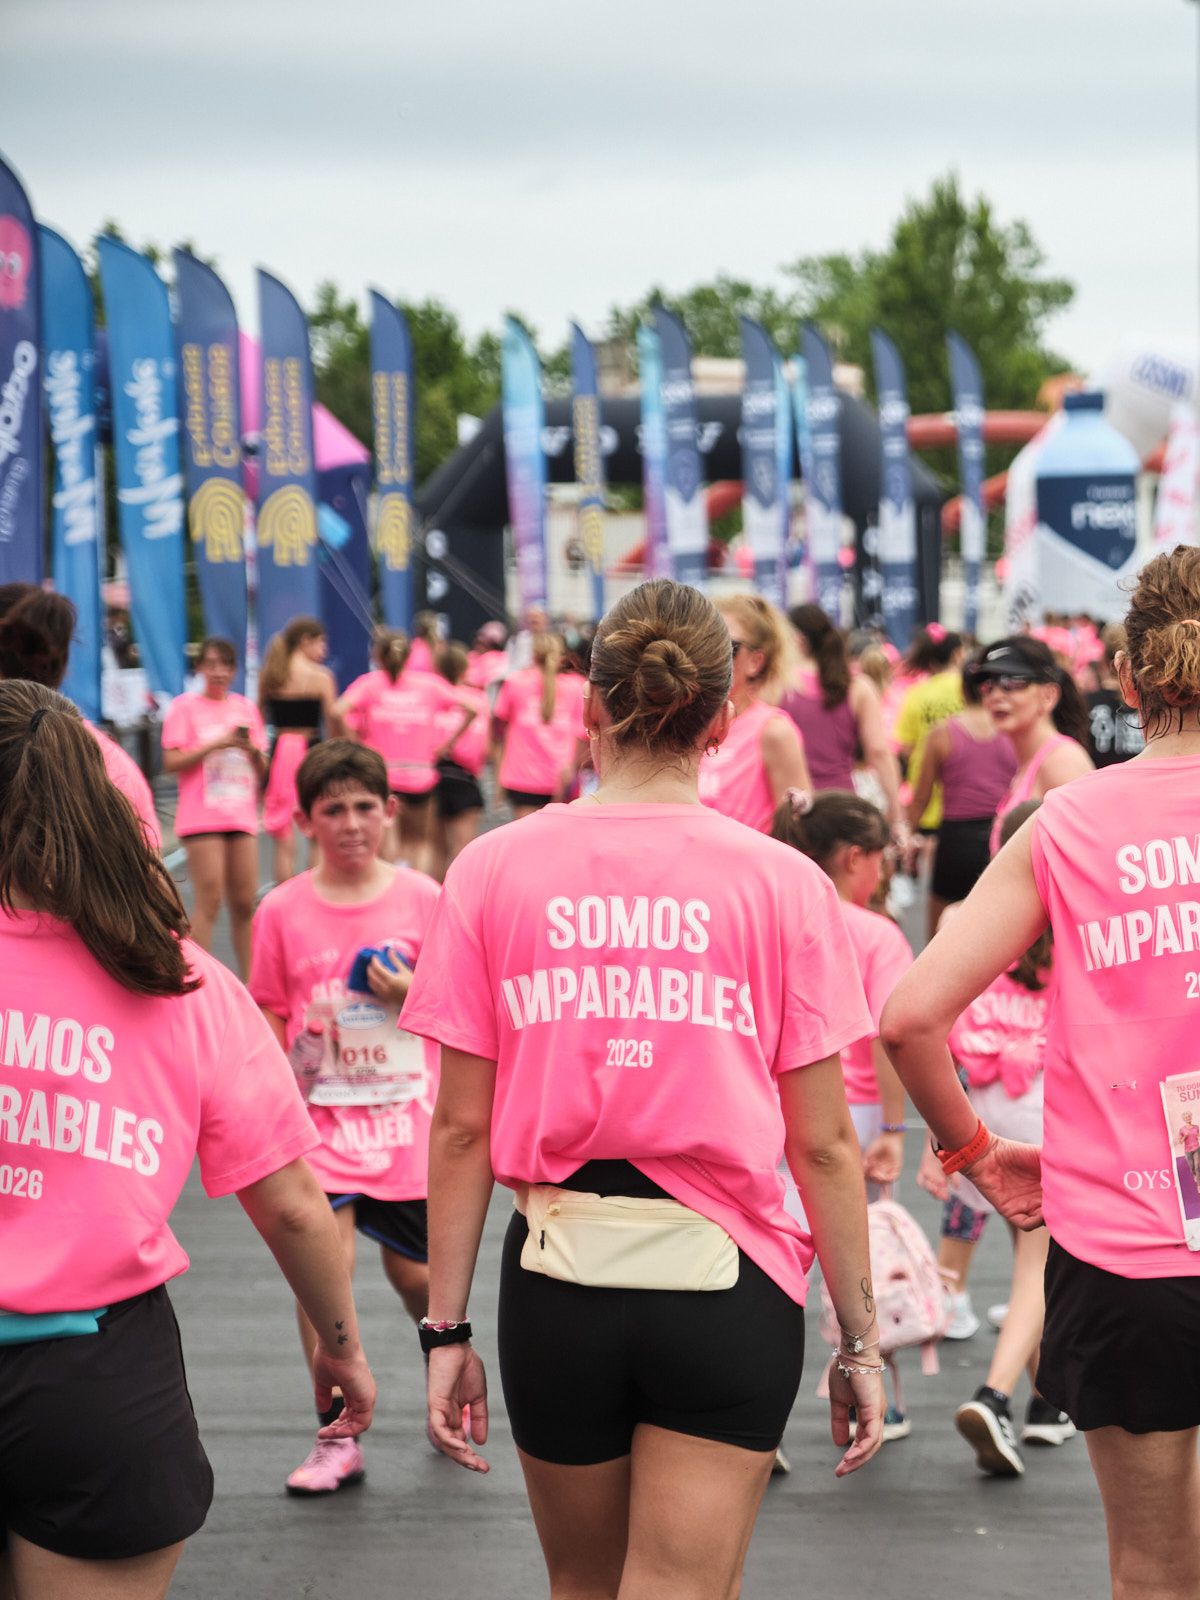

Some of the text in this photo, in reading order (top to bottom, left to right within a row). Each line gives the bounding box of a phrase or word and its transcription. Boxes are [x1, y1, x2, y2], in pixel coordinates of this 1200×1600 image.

[545, 895, 711, 953] SOMOS
[501, 965, 757, 1036] IMPARABLES
[0, 1009, 115, 1083] MOS
[341, 1045, 387, 1067] 016
[606, 1038, 653, 1068] 2026
[0, 1085, 164, 1177] RABLES
[0, 1165, 43, 1199] 026
[1123, 1169, 1172, 1191] OYS
